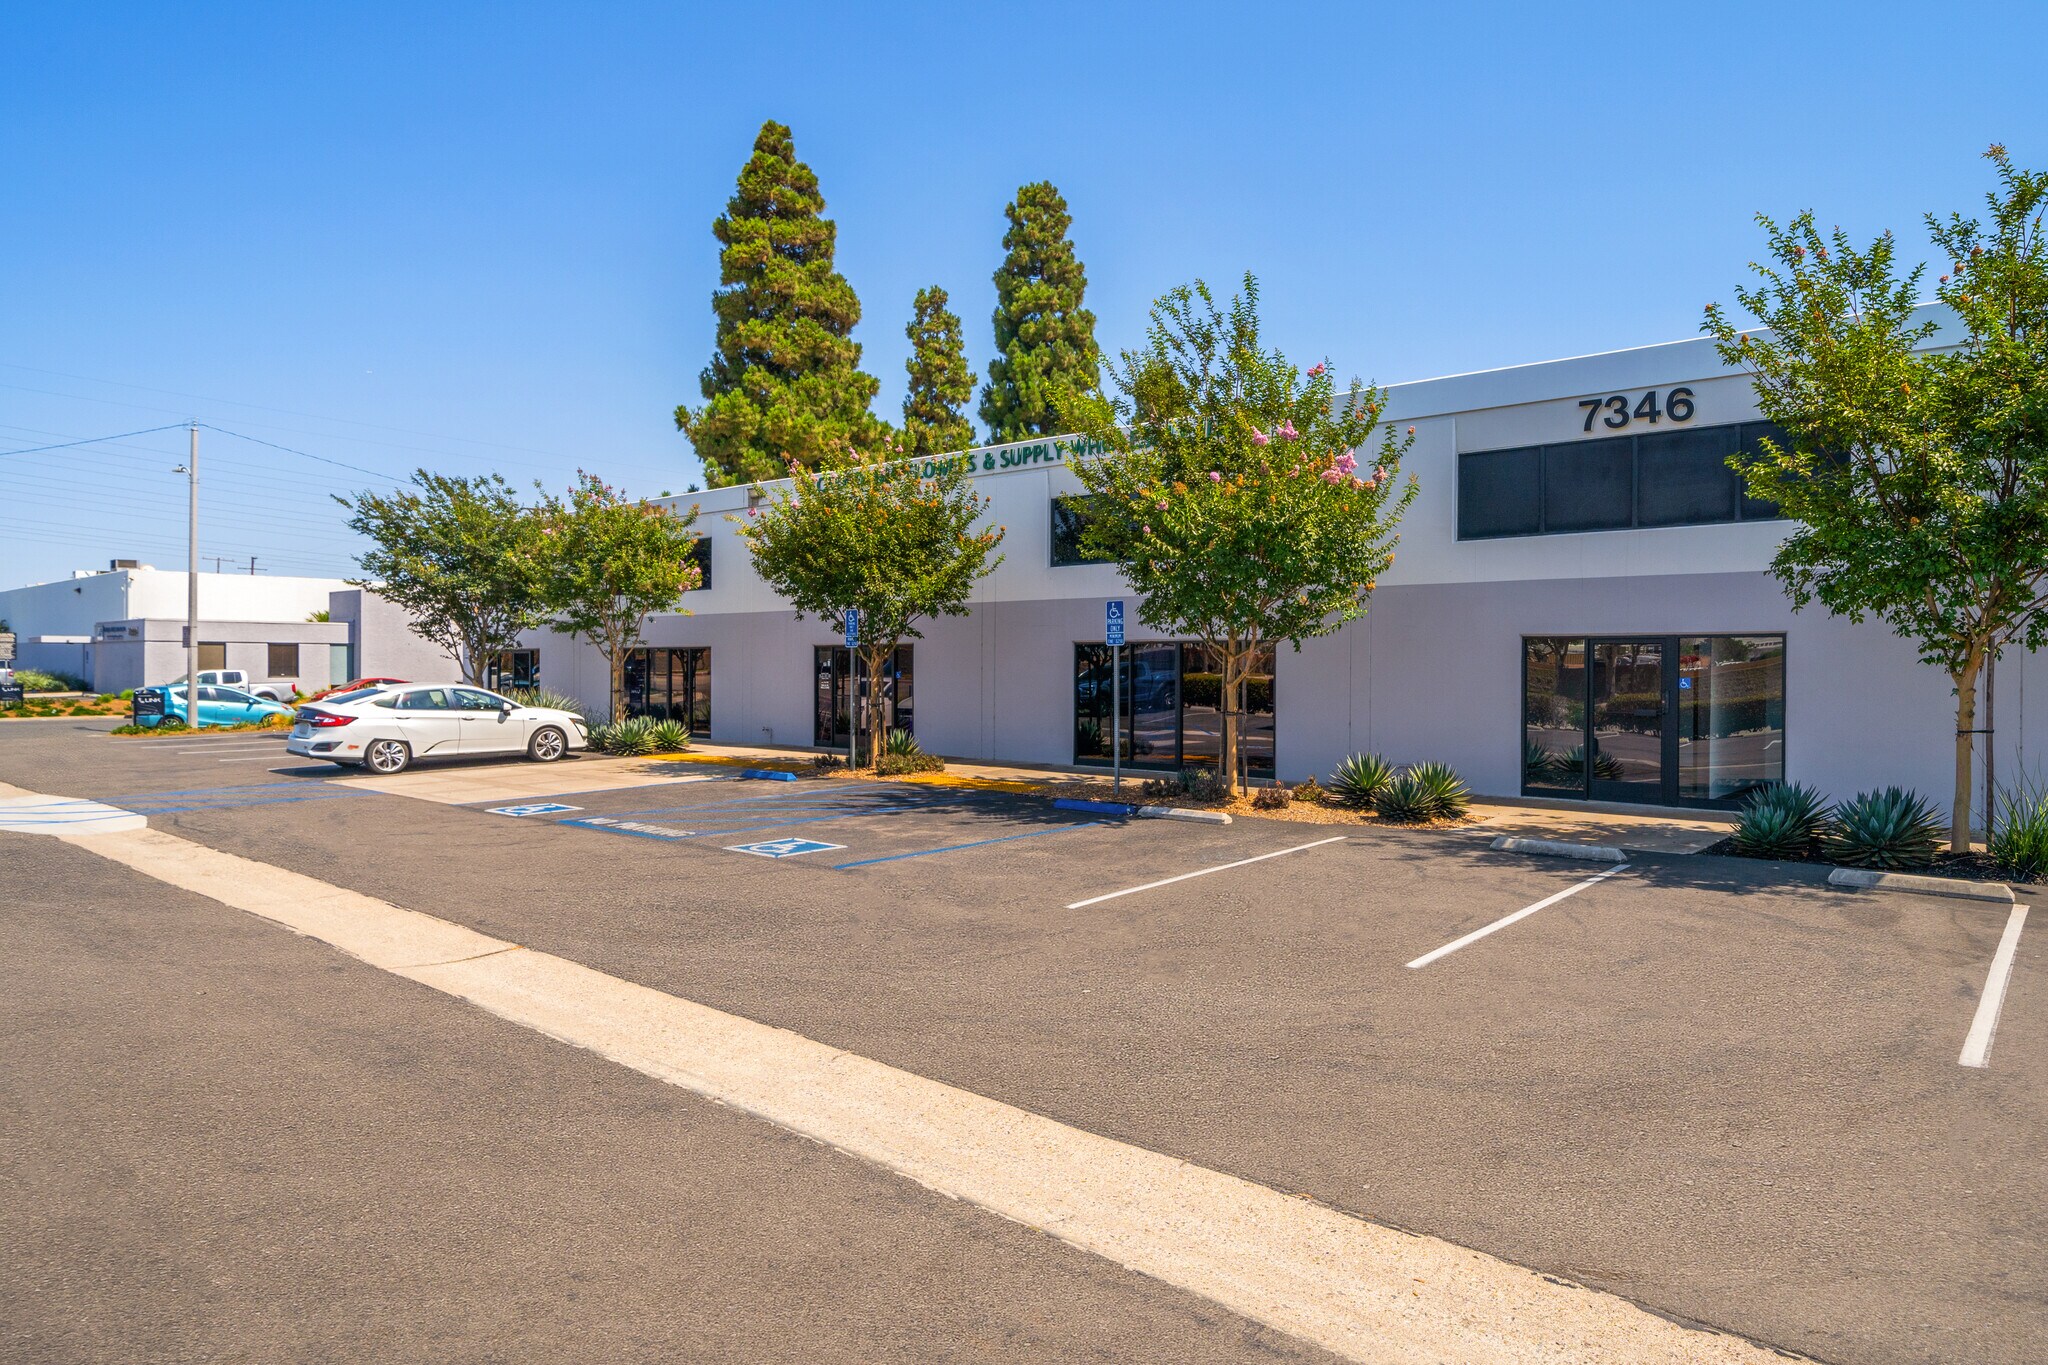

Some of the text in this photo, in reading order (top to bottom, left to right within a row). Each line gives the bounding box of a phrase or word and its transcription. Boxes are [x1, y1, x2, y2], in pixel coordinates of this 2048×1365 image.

[1578, 387, 1695, 432] 7346
[983, 452, 996, 471] &
[1000, 442, 1065, 469] SUPPLY
